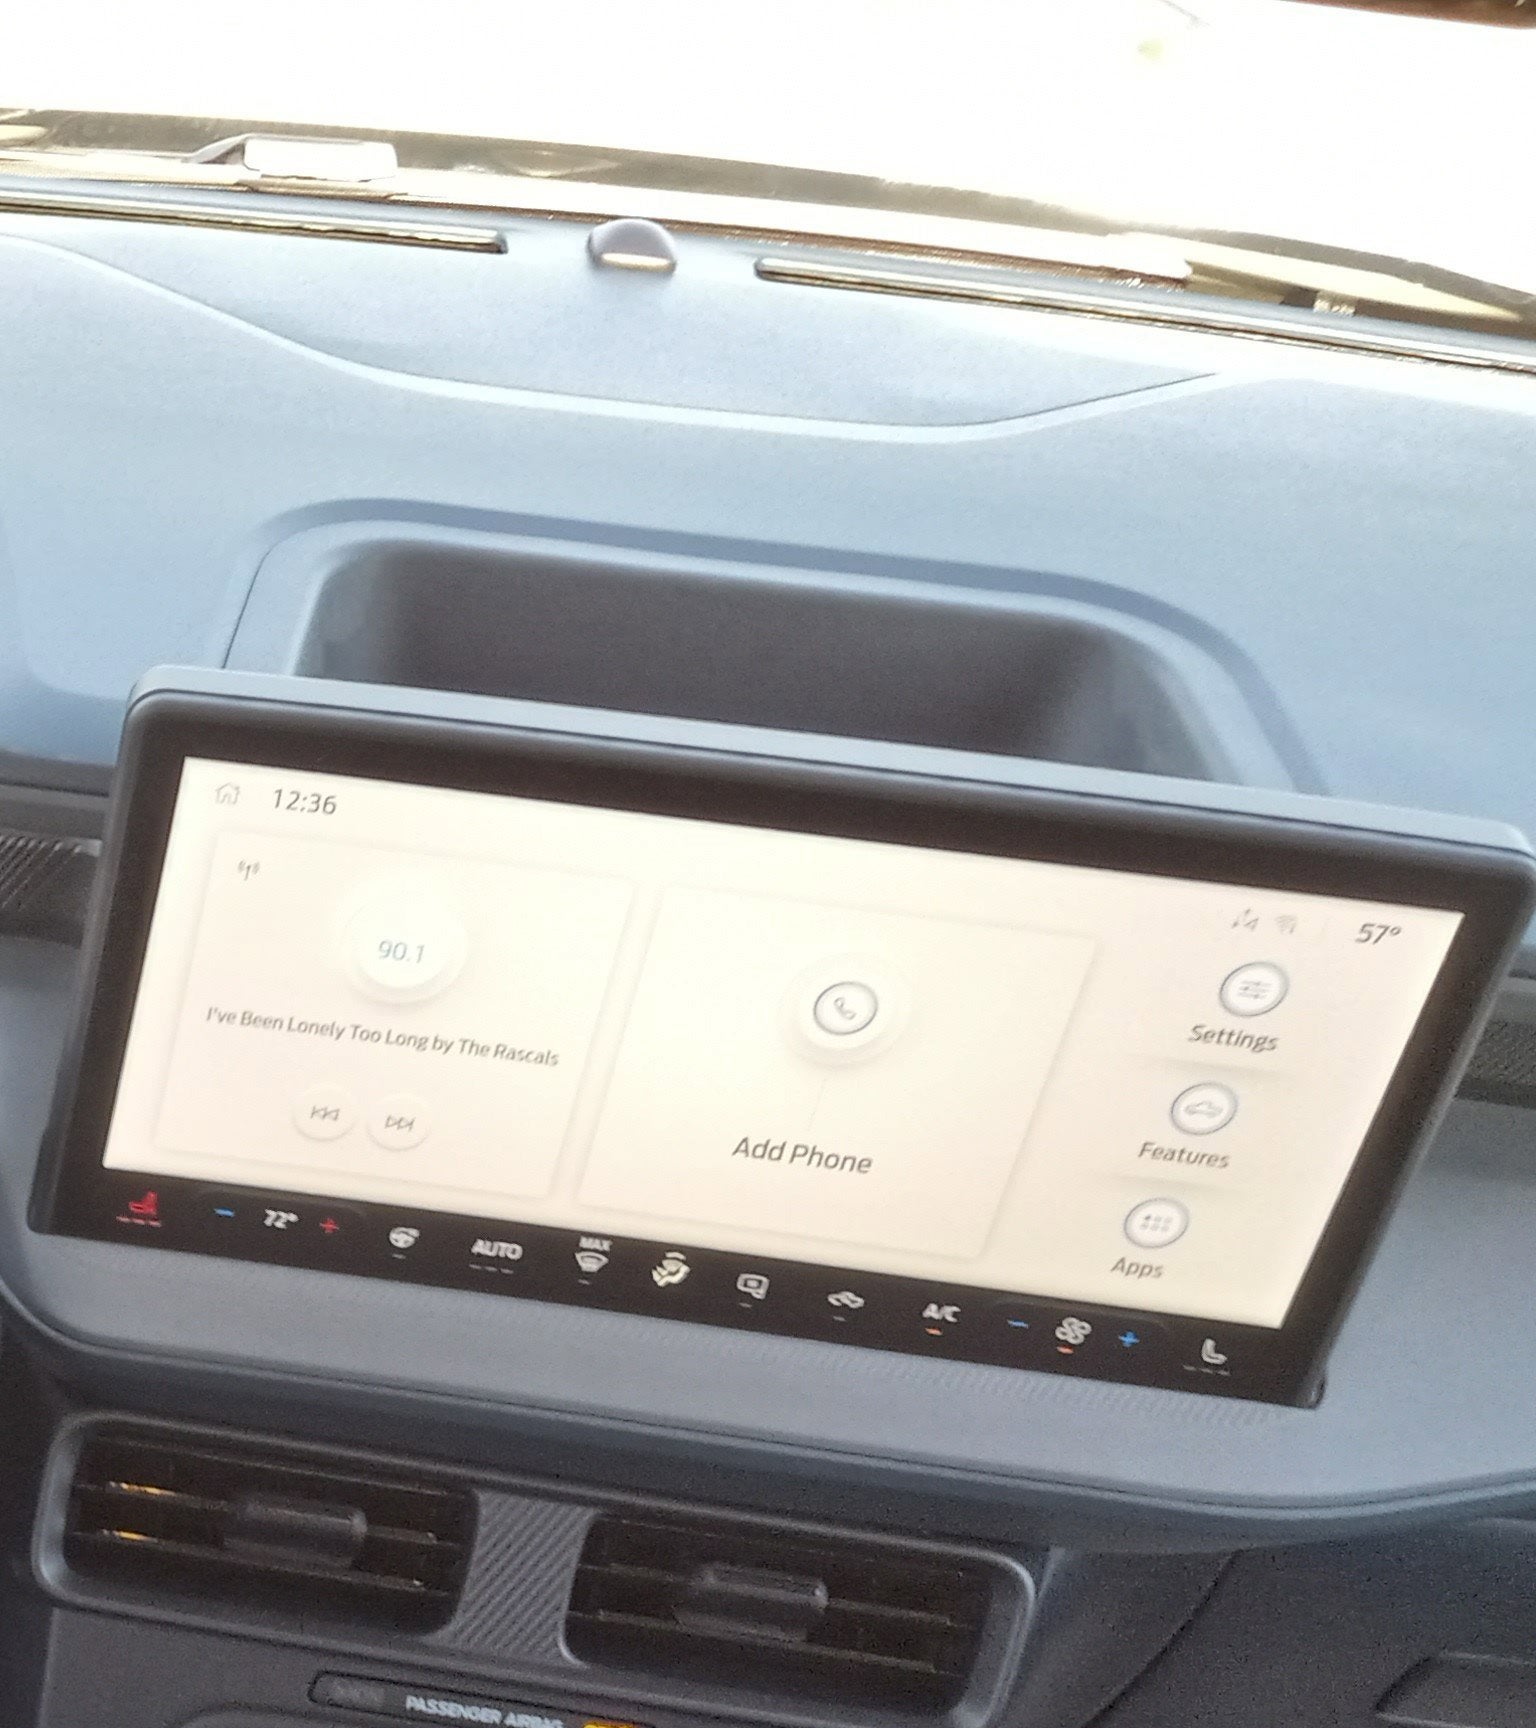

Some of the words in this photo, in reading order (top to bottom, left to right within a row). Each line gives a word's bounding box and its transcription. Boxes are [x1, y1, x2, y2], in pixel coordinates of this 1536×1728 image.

[272, 788, 338, 815] 12:36
[378, 939, 425, 964] 90.1
[207, 1007, 237, 1025] I've
[240, 1010, 283, 1030] Been
[287, 1016, 345, 1041] Lonely
[351, 1024, 381, 1043] Too
[385, 1029, 429, 1052] Long
[432, 1035, 454, 1055] by
[459, 1038, 490, 1058] The
[493, 1043, 559, 1067] Rascals
[1187, 1024, 1279, 1053] Settings
[732, 1136, 785, 1163] Add
[790, 1142, 873, 1175] Phone
[1138, 1141, 1230, 1168] Features
[471, 1237, 524, 1261] AUTO
[579, 1235, 613, 1252] MAX
[1111, 1256, 1164, 1280] Apps
[406, 1695, 502, 1725] PASSENGER
